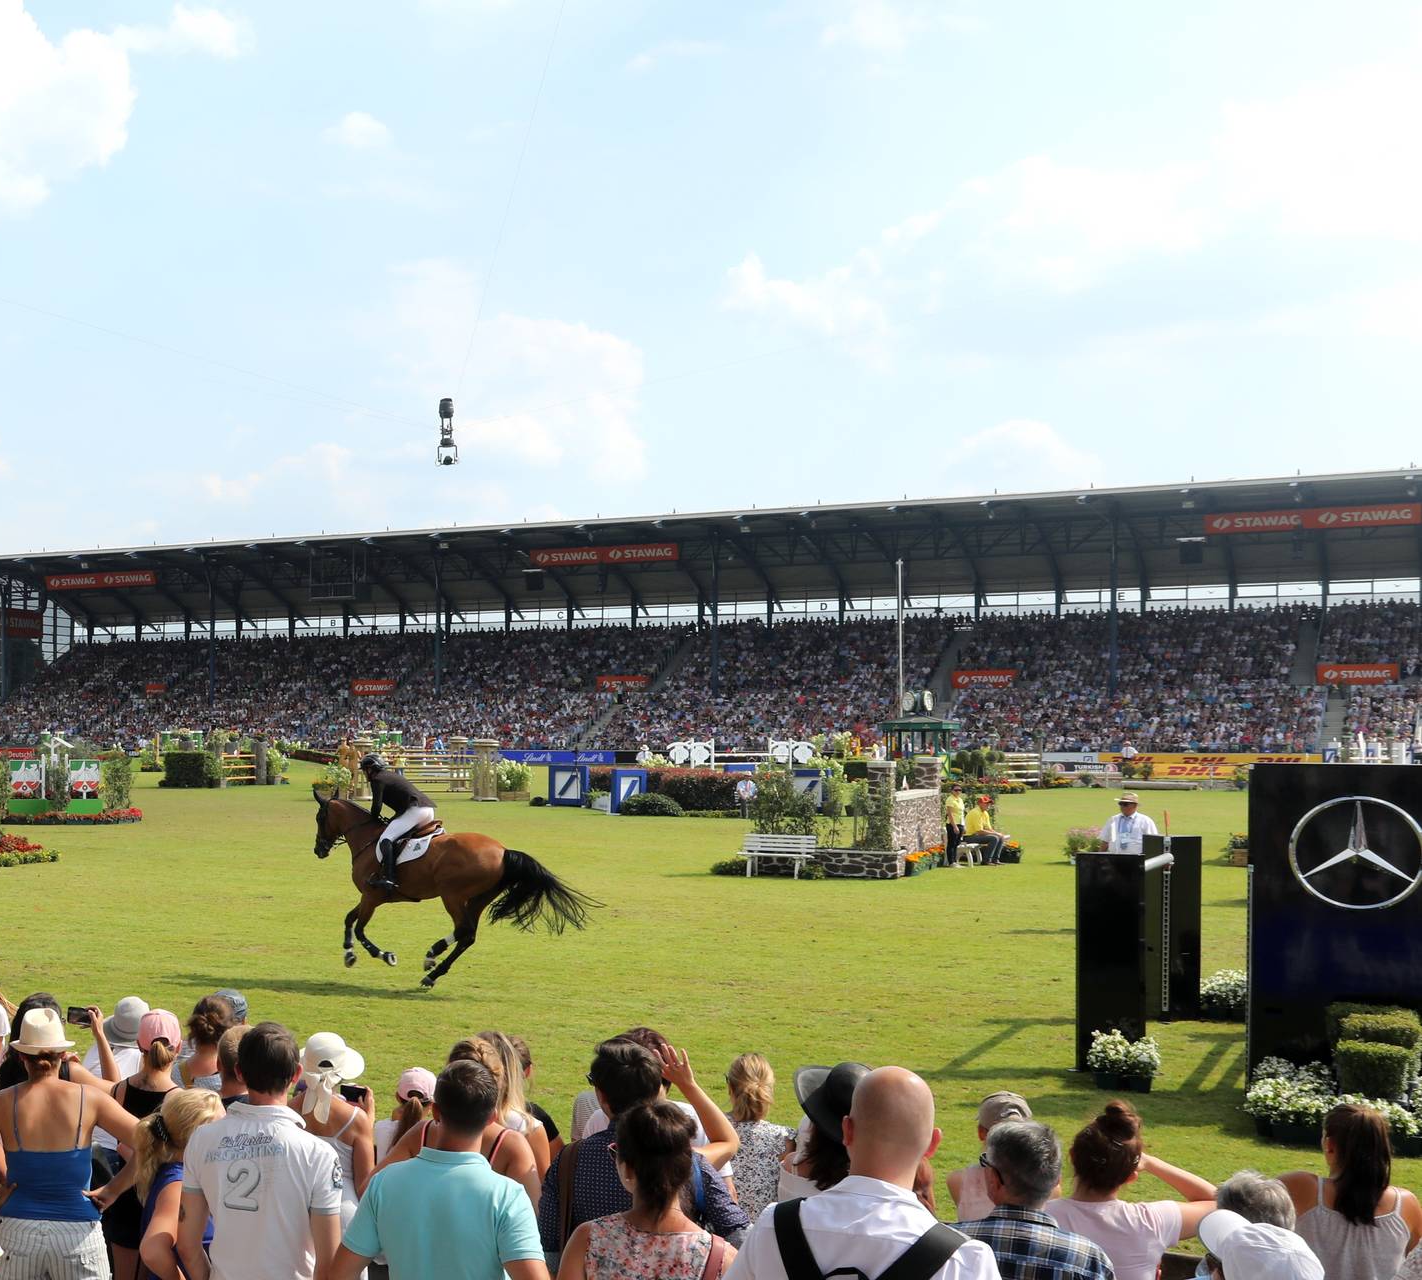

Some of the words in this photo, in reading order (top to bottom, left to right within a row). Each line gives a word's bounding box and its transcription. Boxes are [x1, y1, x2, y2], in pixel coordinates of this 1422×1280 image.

[1341, 509, 1412, 522] STAWAG
[1233, 514, 1302, 528] STAWAG
[551, 551, 598, 562] STAWAG
[624, 548, 672, 558] STAWAG
[61, 577, 97, 586] STAWAG
[115, 574, 151, 584] STAWAG
[522, 752, 546, 762] Lindt
[1168, 766, 1222, 776] DHL
[223, 1159, 261, 1212] 2
